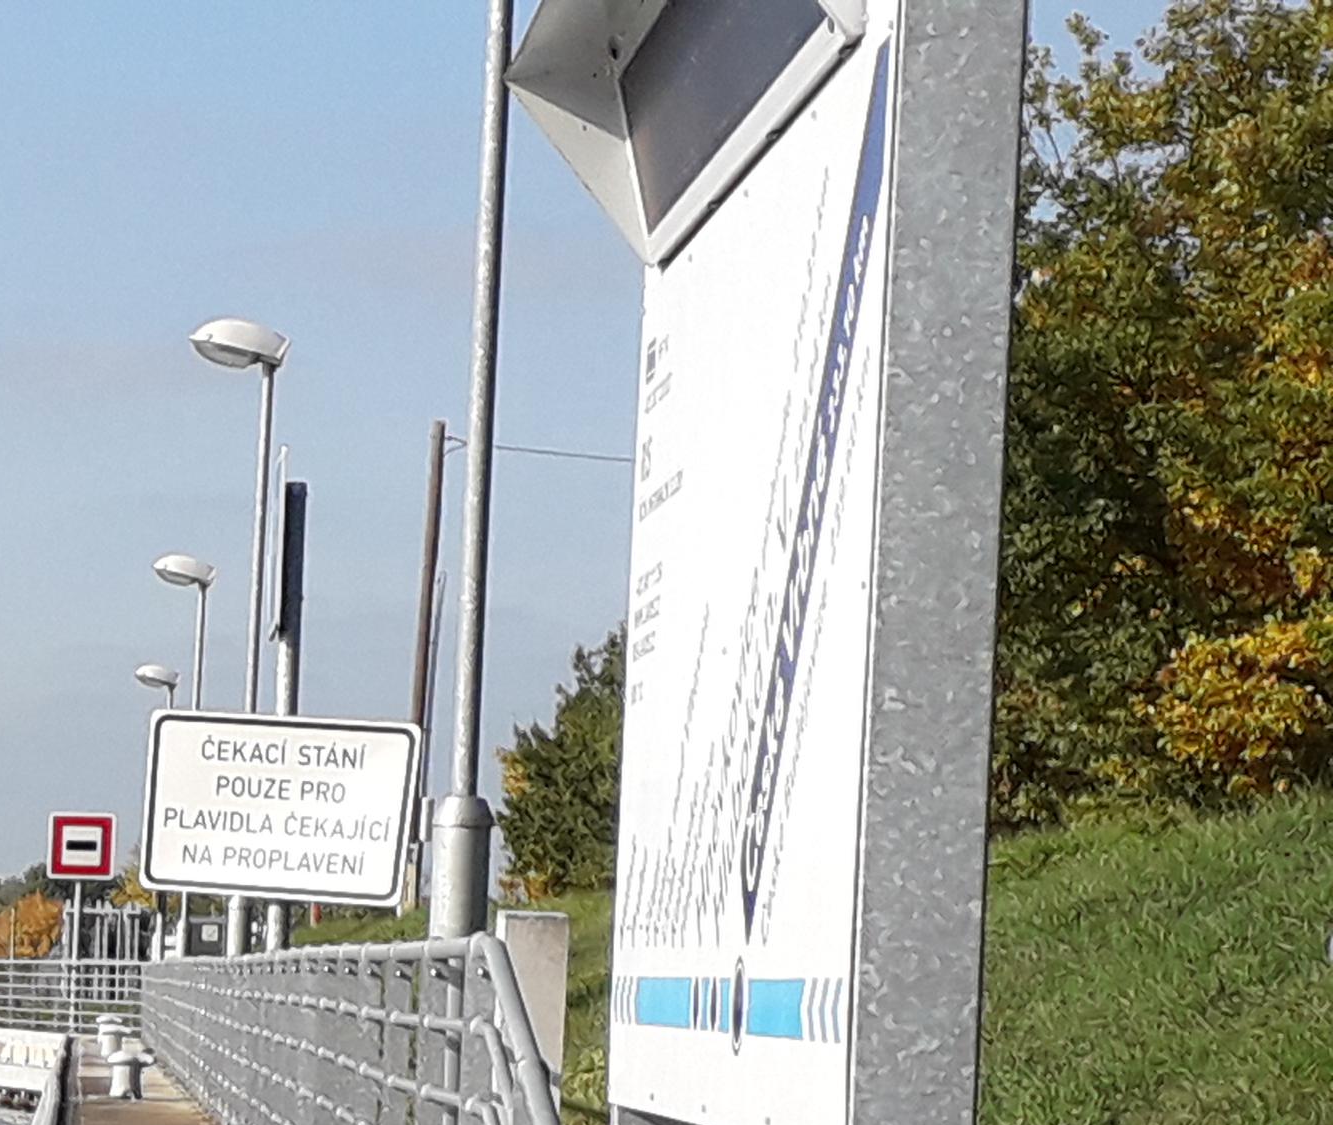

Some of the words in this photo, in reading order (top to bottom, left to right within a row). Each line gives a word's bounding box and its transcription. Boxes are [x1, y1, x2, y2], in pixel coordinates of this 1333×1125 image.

[201, 734, 288, 766] ČEKACÍ
[297, 742, 367, 769] STÁNÍ
[215, 775, 292, 801] POUZE
[300, 780, 346, 803] PRO
[163, 807, 274, 835] PLAVIDLA
[284, 811, 391, 842] ČEKAJÍCÍ
[181, 843, 213, 866] NA
[222, 846, 365, 876] PROPLAVENÍ
